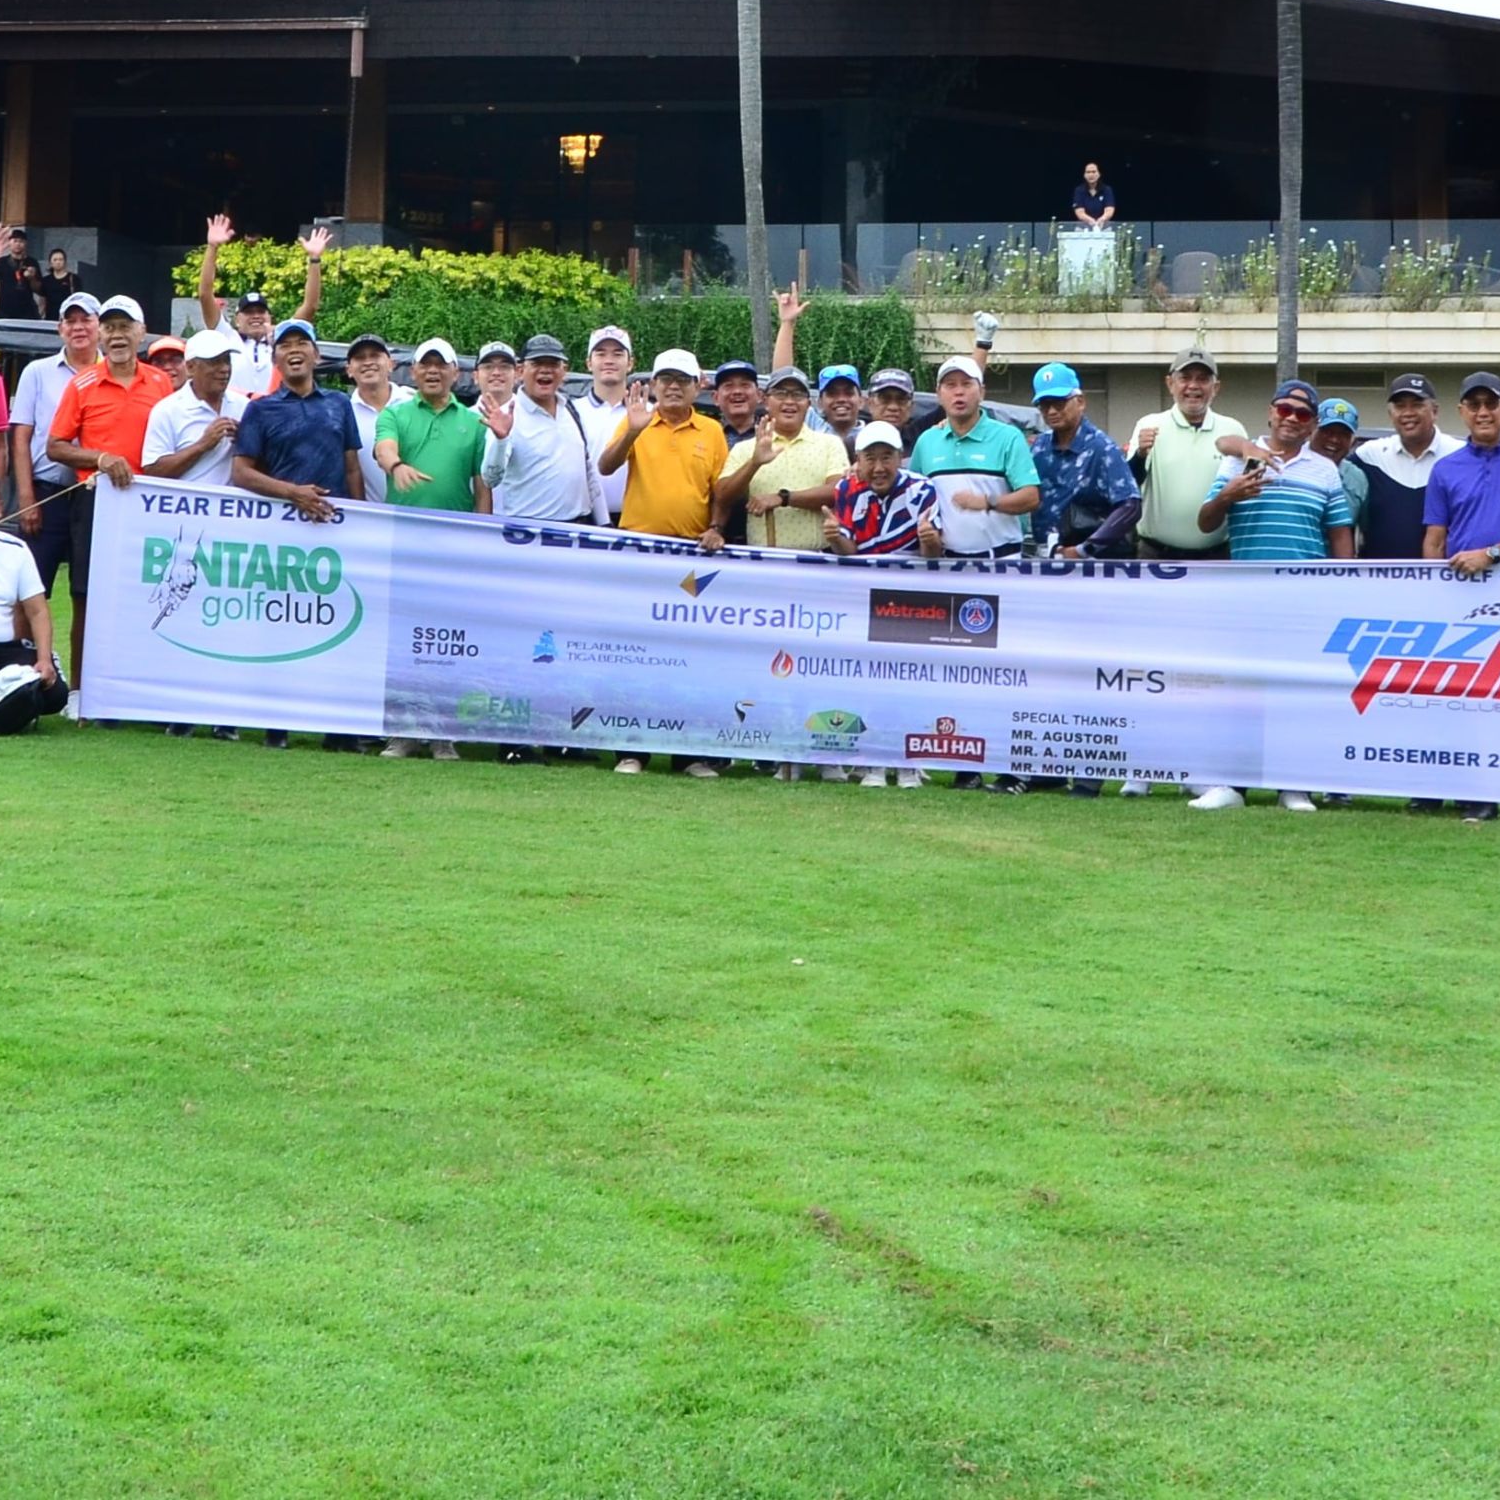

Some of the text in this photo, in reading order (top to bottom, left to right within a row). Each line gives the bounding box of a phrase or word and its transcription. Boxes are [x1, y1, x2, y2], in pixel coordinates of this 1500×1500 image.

[141, 493, 210, 516] YEAR
[219, 499, 273, 520] END
[1368, 566, 1432, 582] INDAH
[651, 602, 847, 637] universalbpr
[875, 603, 947, 620] wetrade
[412, 626, 466, 642] SSOM
[412, 641, 479, 657] STUDIO
[566, 640, 647, 653] PELABUHAN
[568, 651, 596, 662] TIGA
[797, 655, 1028, 688] QUALITA MINERAL INDONESIA
[1096, 667, 1166, 694] MFS
[1379, 696, 1443, 709] GOLF
[599, 715, 685, 731] VIDA LAW
[1012, 711, 1069, 725] SPECIAL
[1073, 714, 1128, 728] THANKS
[716, 728, 772, 744] AVIARY
[1011, 729, 1119, 745] MR. AGUSTORI
[909, 737, 982, 756] BALI HAI
[1010, 745, 1127, 762] MR. A. DAWAMI
[1344, 745, 1357, 761] 8
[1363, 747, 1480, 768] DESEMBER
[1010, 762, 1189, 781] MR. MOH. OMAR RAMA P
